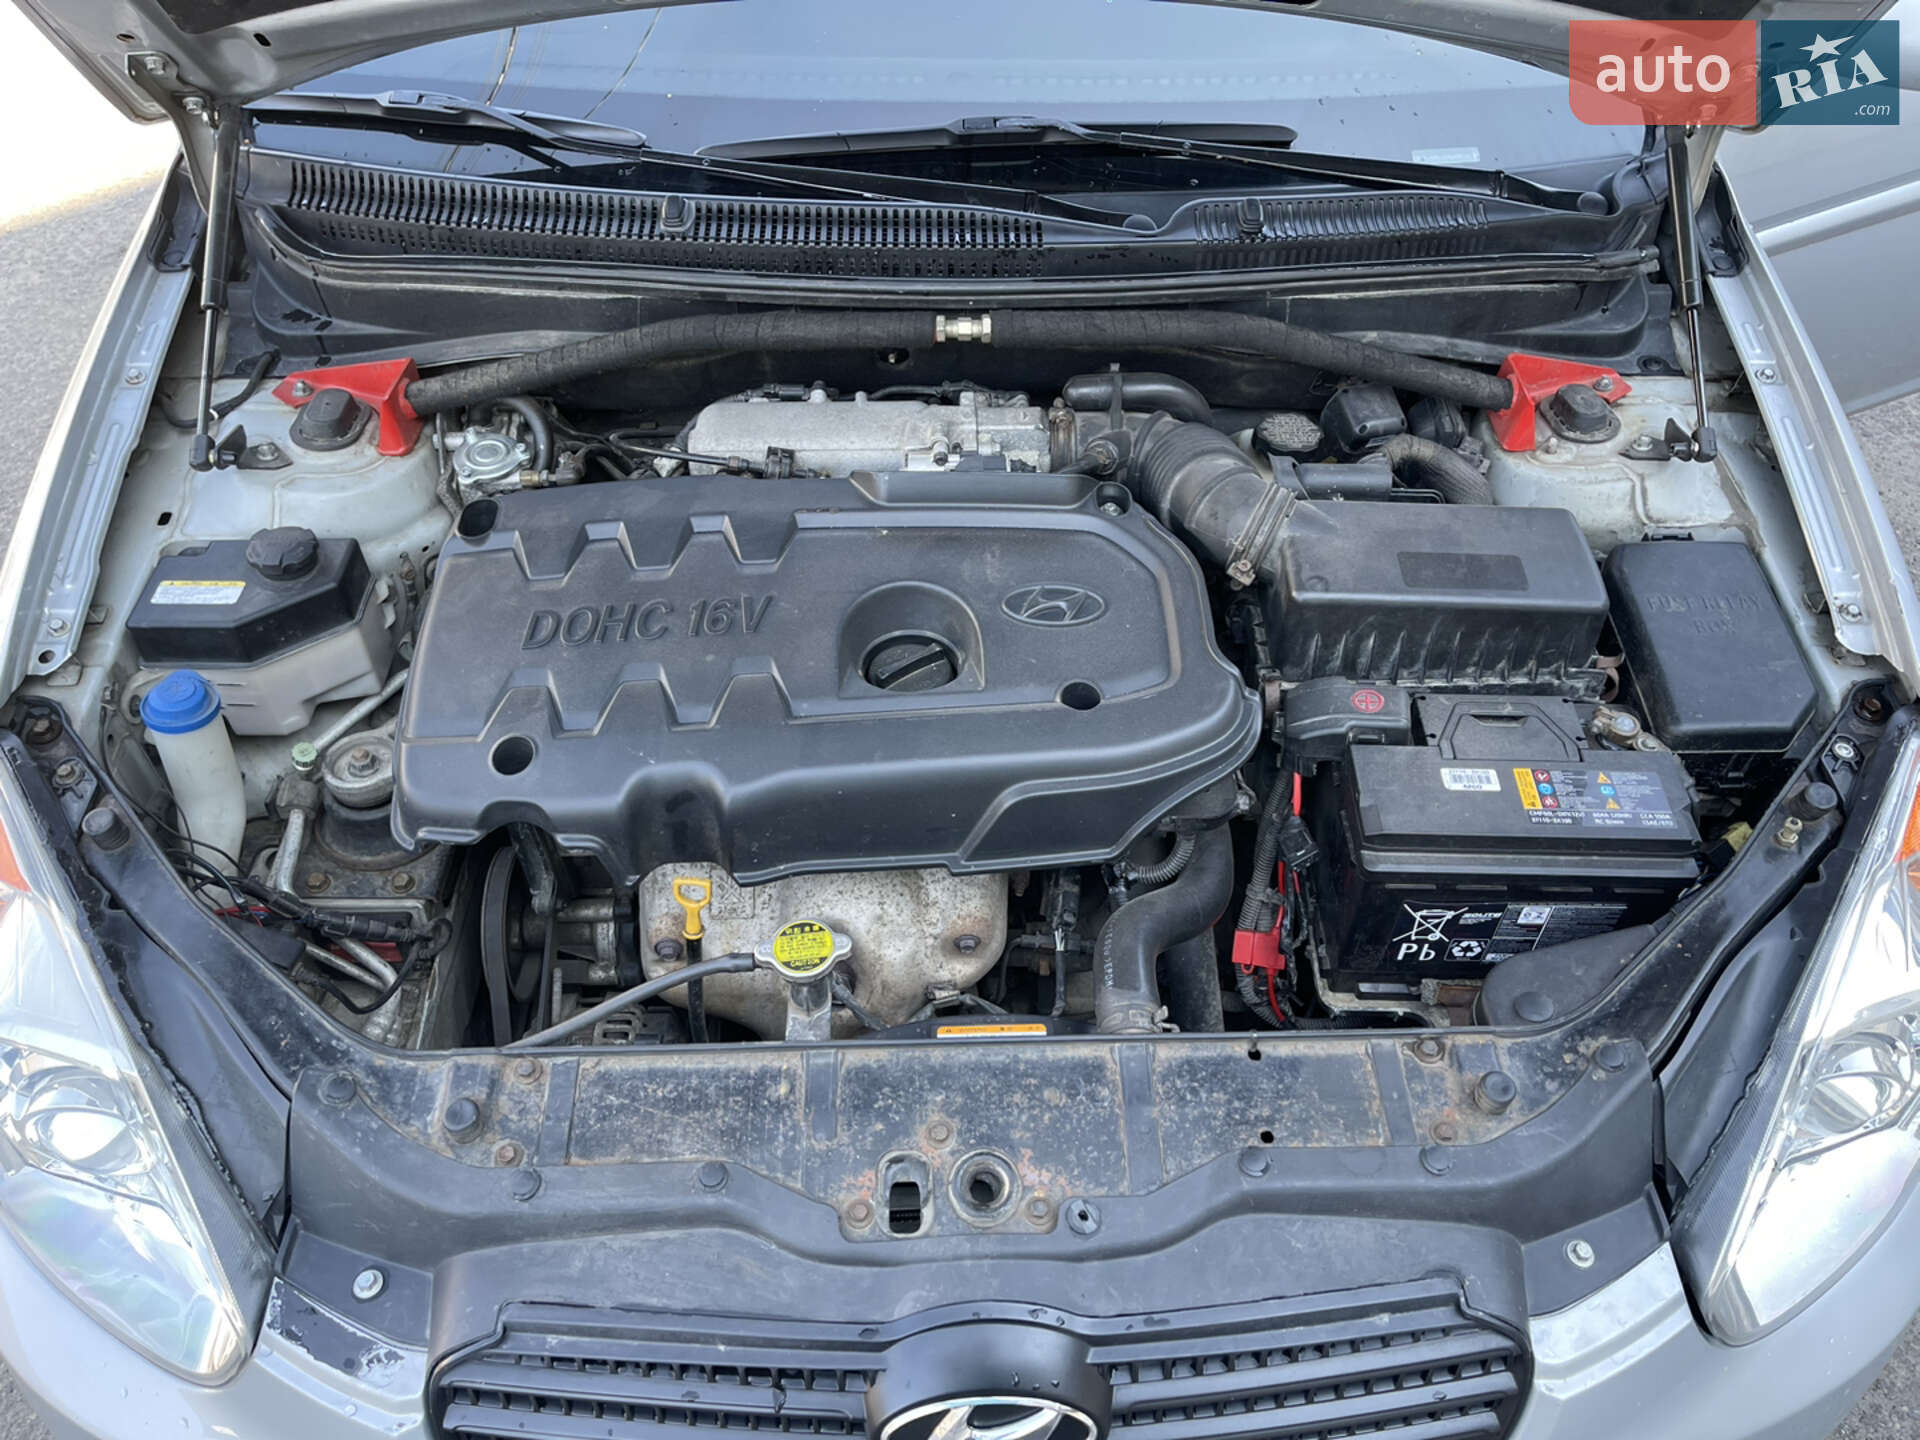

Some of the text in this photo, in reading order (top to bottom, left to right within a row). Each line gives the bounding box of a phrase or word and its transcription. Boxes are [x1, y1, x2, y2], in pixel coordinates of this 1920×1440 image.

[520, 592, 776, 650] DOHC 16V
[1397, 942, 1436, 961] Pb
